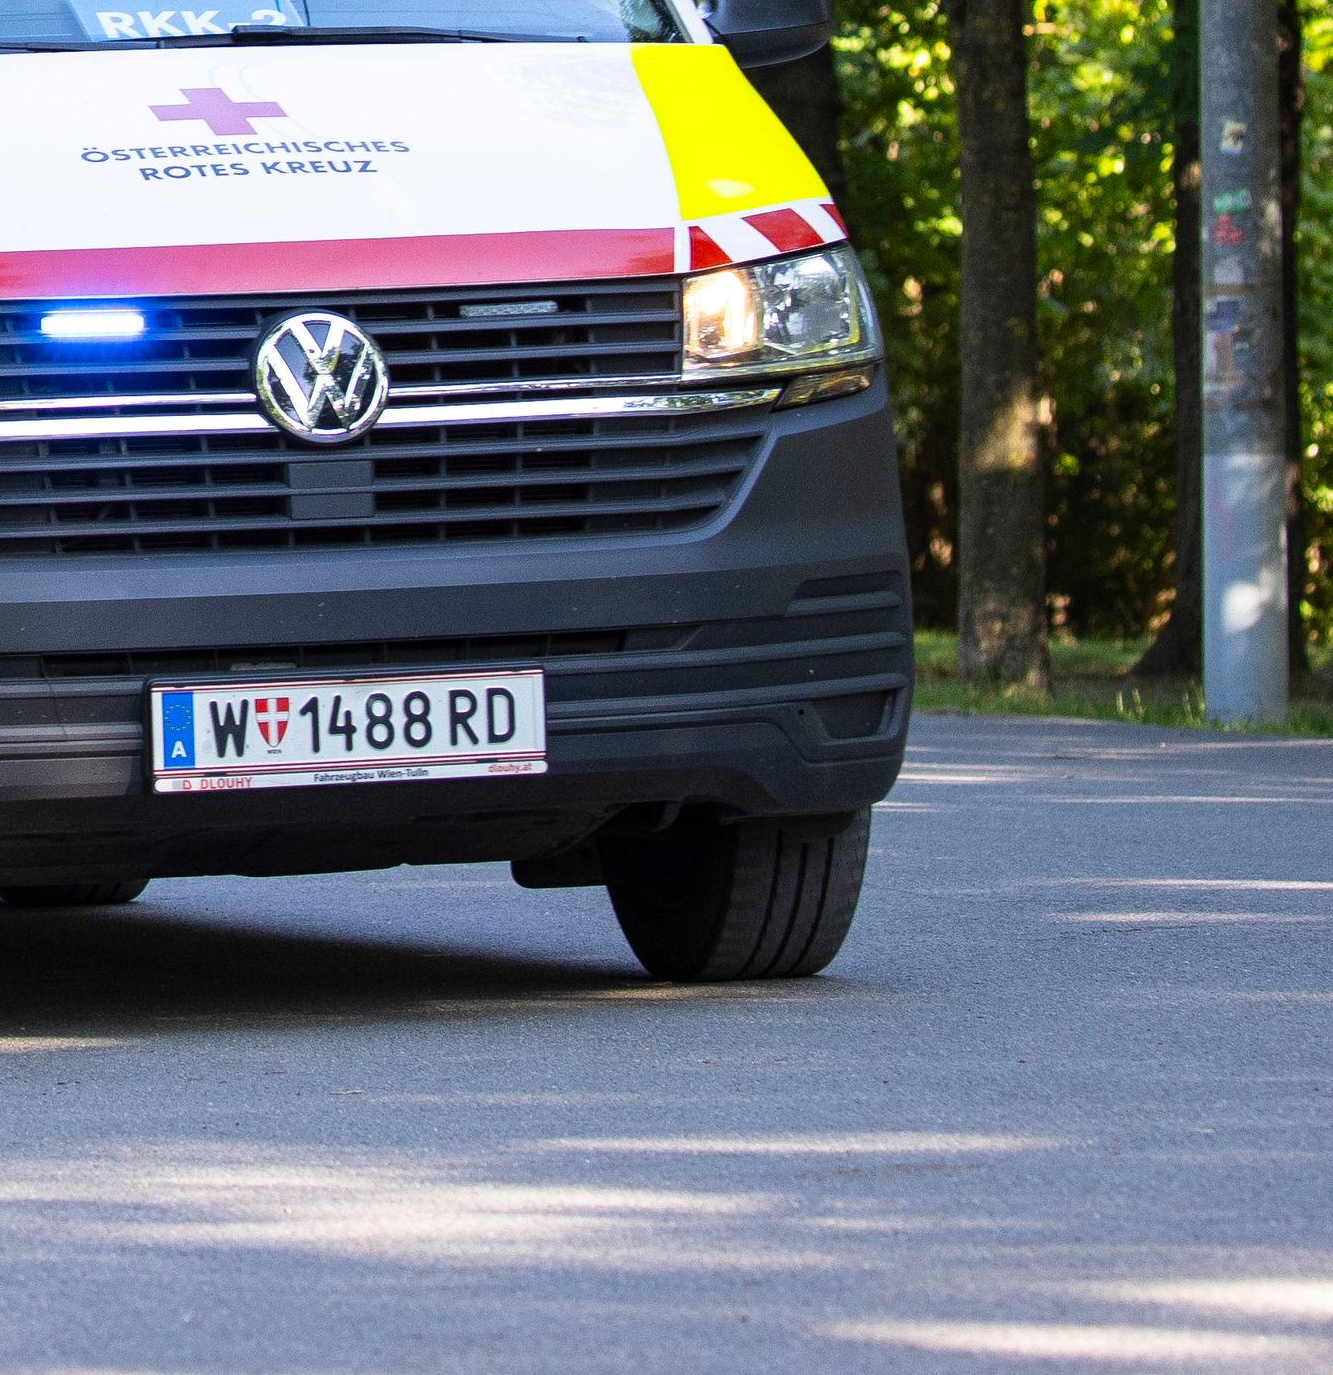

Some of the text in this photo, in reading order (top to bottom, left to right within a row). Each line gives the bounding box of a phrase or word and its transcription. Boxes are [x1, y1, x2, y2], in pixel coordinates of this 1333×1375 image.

[81, 140, 411, 163] ÖSTERREICHISCHES
[139, 160, 378, 181] ROTES KREUZ
[256, 313, 388, 435] VW
[210, 698, 249, 758] W
[171, 741, 187, 758] A
[200, 777, 252, 789] DLOUHY
[313, 772, 375, 782] Fahrzeugbau
